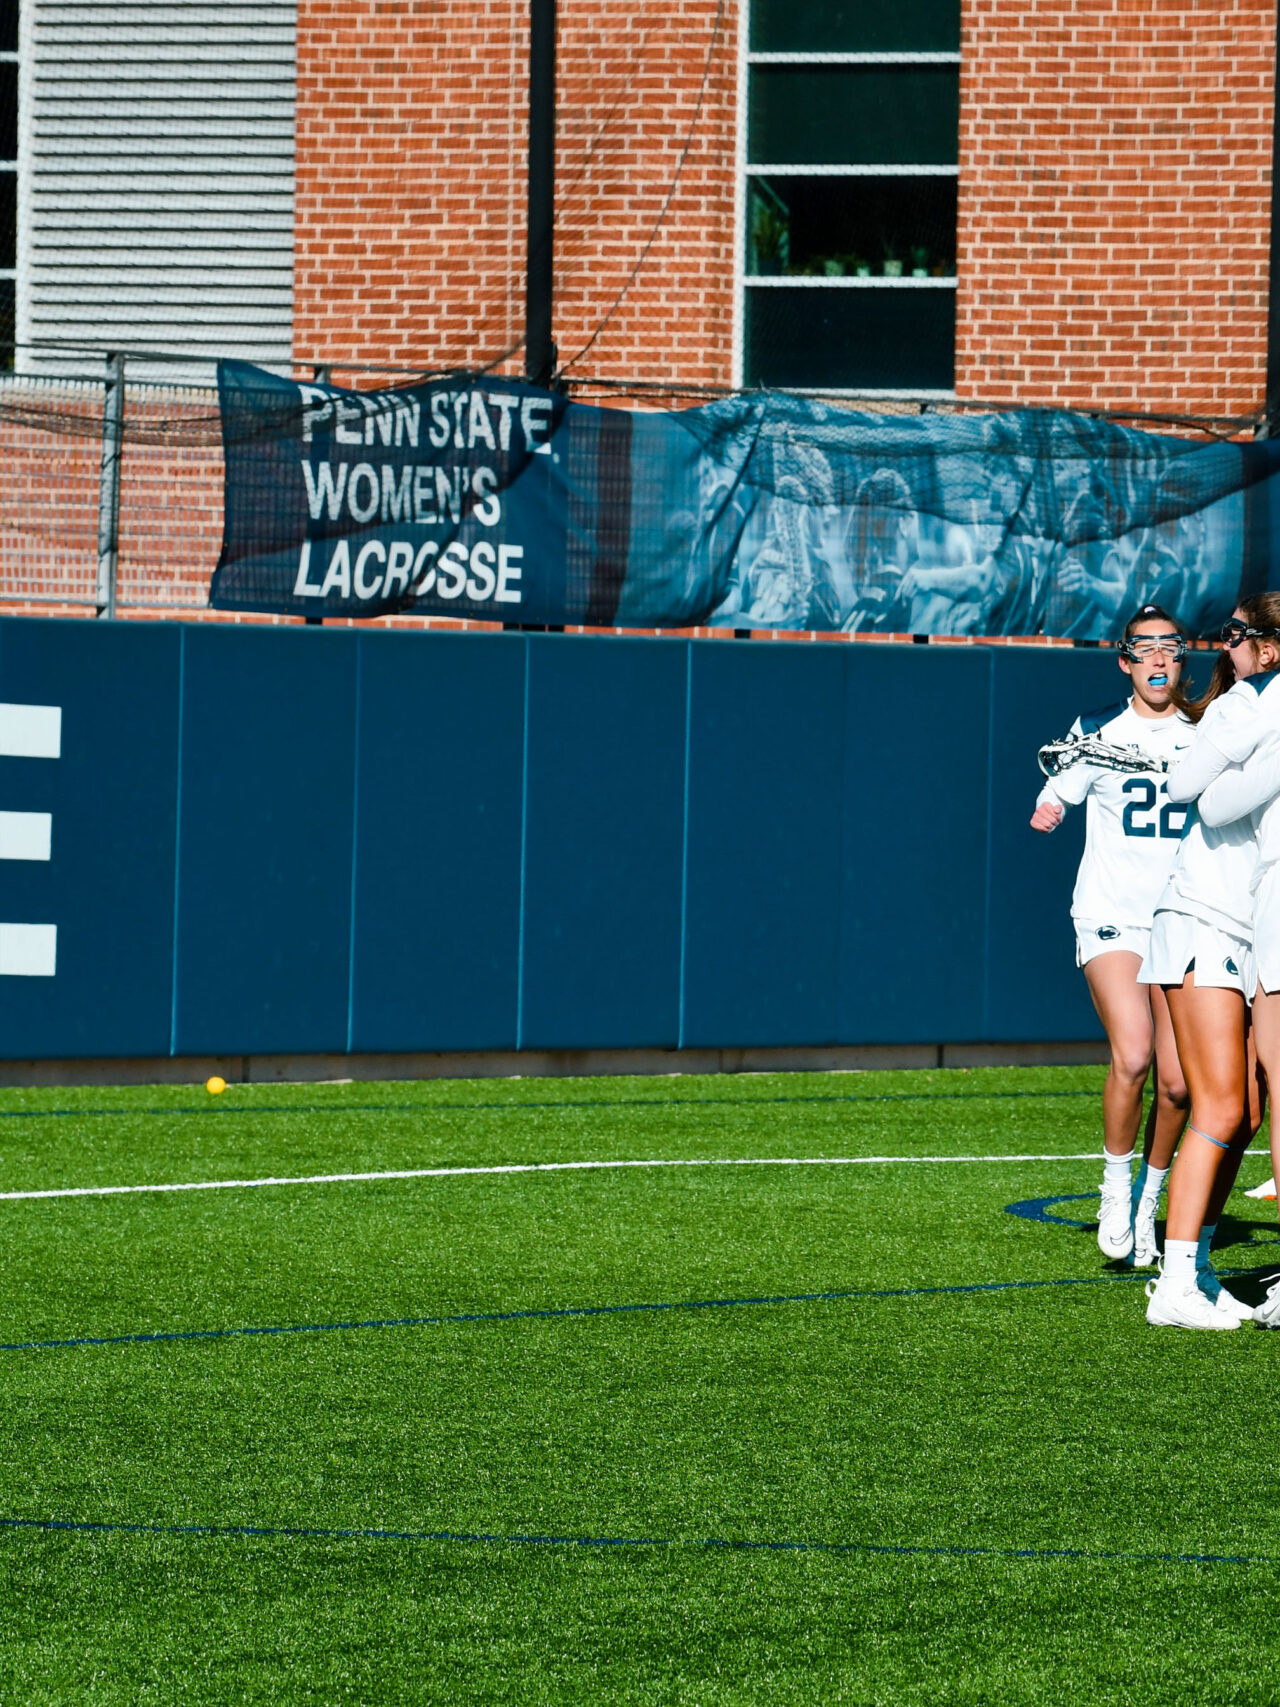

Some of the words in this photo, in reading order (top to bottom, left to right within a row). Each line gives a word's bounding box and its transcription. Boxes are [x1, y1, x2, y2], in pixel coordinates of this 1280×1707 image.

[298, 385, 420, 446] PENN
[428, 391, 553, 455] STATE
[301, 460, 500, 526] WOMEN'S
[294, 539, 524, 603] LACROSSE
